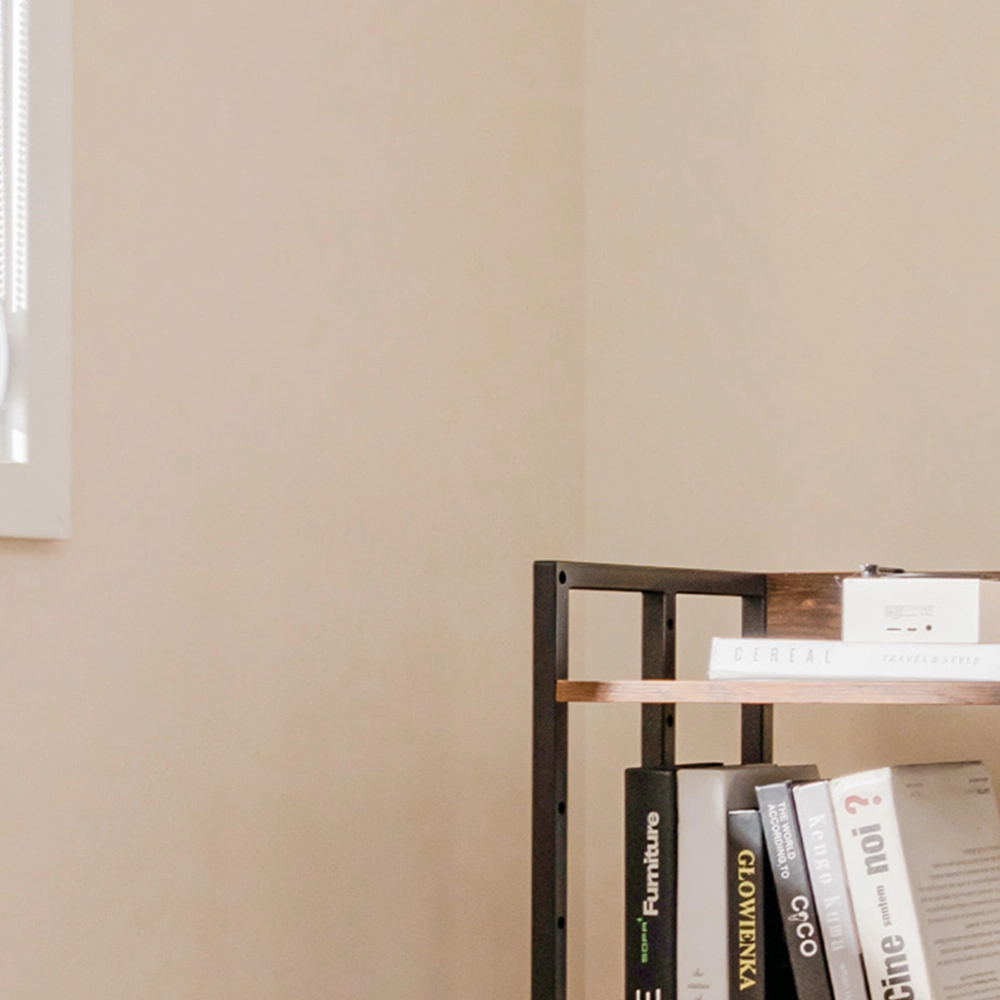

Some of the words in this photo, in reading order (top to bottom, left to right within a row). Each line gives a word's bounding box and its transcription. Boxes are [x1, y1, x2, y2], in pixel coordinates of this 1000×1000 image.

[733, 646, 832, 665] CEREAL
[776, 802, 788, 820] THE
[642, 811, 661, 916] Furniture
[781, 821, 796, 860] WORLD
[851, 823, 890, 877] noi
[807, 813, 833, 885] Kengo
[825, 894, 844, 952] Kuma
